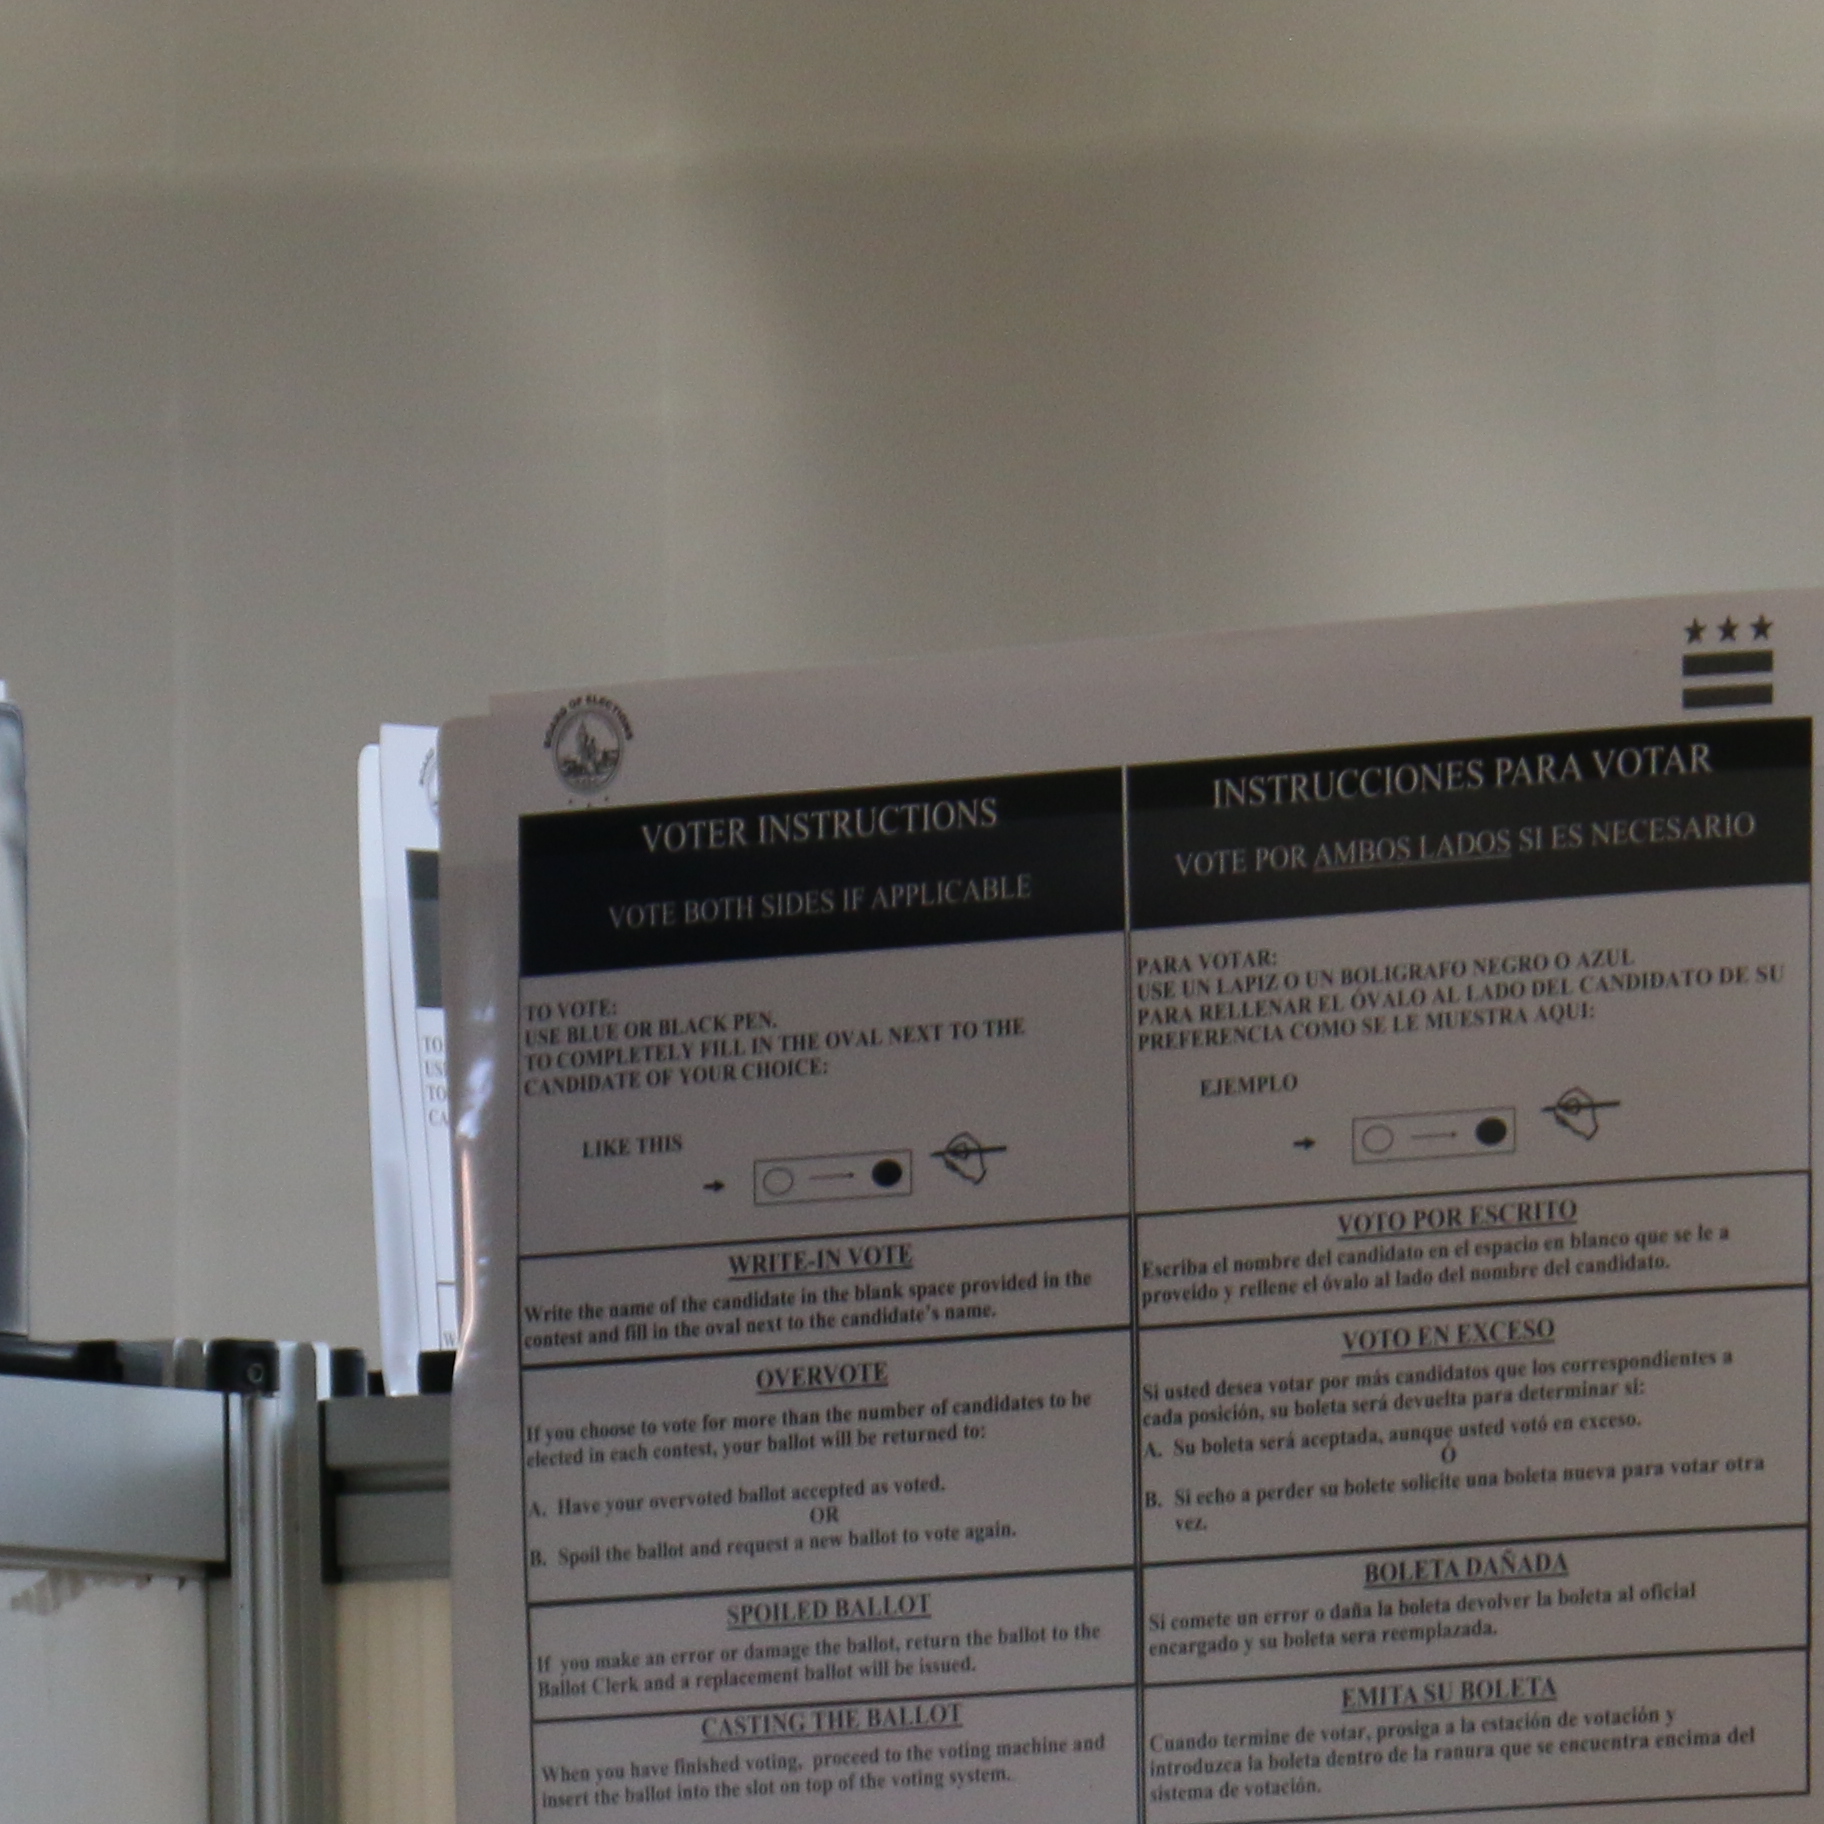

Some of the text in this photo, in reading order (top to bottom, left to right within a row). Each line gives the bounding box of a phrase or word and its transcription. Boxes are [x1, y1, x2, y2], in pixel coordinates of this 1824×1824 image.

[1213, 742, 1712, 809] INSTRUCCIONES PARA VOTAR
[641, 797, 998, 852] VOTER INSTRUCTIONS
[1175, 810, 1756, 877] VOTE POR AMBOS LADOS SI ES NECESARIO
[608, 873, 1031, 929] VOTE BOTH SIDES IF APPLICABLE
[1136, 948, 1277, 976] PARA VOTAR:
[1137, 981, 1176, 1001] USE
[1182, 978, 1210, 997] UN
[1283, 971, 1300, 991] O
[1306, 968, 1334, 989] UN
[1472, 953, 1549, 976] NEGRO
[1553, 951, 1572, 971] O
[1577, 947, 1635, 969] AZUL
[527, 998, 617, 1021] TO VOTE:
[1137, 962, 1785, 1027] PARA RELLENAR EL ÓVALO AL LADO DEL CANDIDATO DE SU
[525, 1010, 777, 1047] USE BLUE OR BLACK PEN.
[526, 1016, 1026, 1071] TO COMPLETELY FILL IN THE OVAL NEXT TO THE
[1137, 1024, 1285, 1051] PREFERENCIA
[1288, 1018, 1357, 1041] COMO
[1360, 1015, 1387, 1035] SE
[1392, 1013, 1419, 1033] LE
[1425, 1007, 1528, 1031] MUESTRA
[524, 1056, 829, 1097] CANDIDATE OF YOUR CHOICE:
[1200, 1073, 1299, 1098] EJEMPLO
[582, 1134, 683, 1160] LIKE THIS
[1337, 1199, 1578, 1235] VOTO POR ESCRITO
[728, 1242, 913, 1276] WRITE-IN VOTE
[1342, 1316, 1556, 1351] VOTO EN EXCESO
[755, 1361, 890, 1391] OVERVOTE
[529, 1473, 946, 1518] A. Have your overvoted ballot accepted as voted.
[809, 1504, 842, 1526] OR
[1364, 1549, 1569, 1585] BOLETA DAÑADA
[726, 1592, 931, 1626] SPOILED BALLOT
[1341, 1675, 1557, 1710] EMITA SU BOLETA
[701, 1702, 962, 1739] CASTING THE BALLOT
